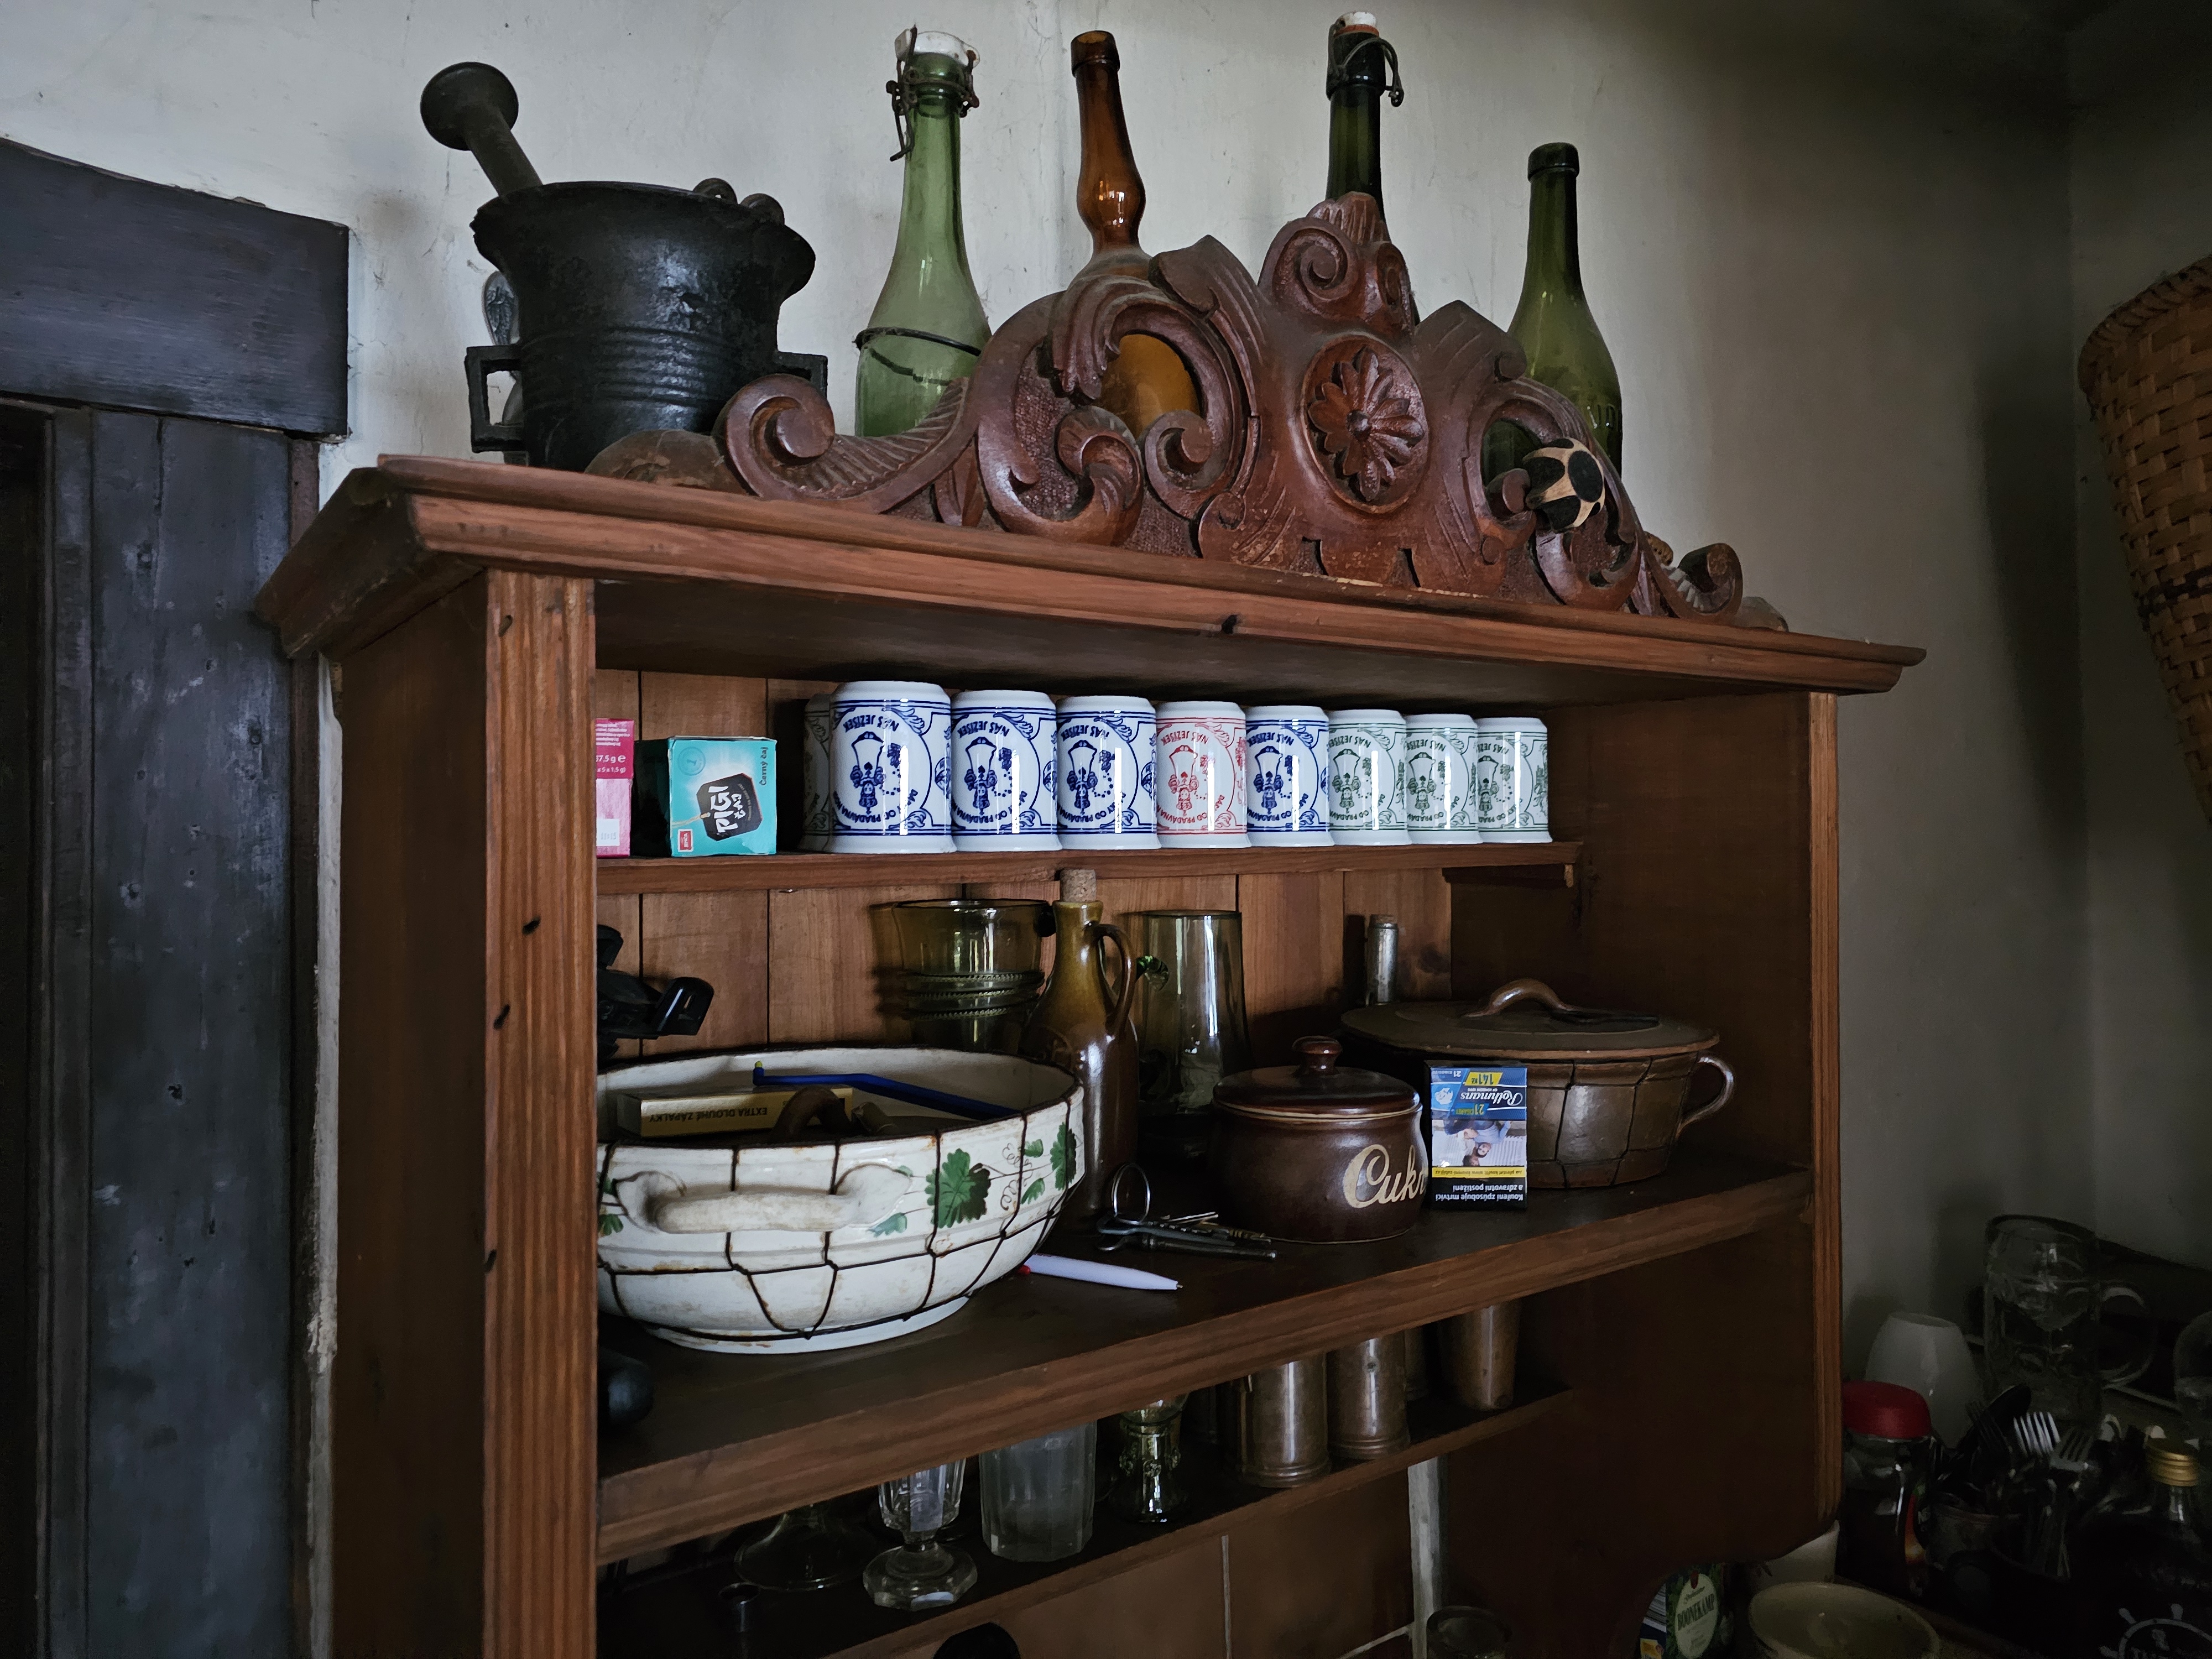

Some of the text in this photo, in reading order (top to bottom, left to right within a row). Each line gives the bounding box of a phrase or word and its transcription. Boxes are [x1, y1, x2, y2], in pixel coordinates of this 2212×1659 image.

[759, 761, 768, 785] Černý
[708, 786, 738, 833] PIGI
[1095, 811, 1107, 820] OD
[1197, 812, 1207, 821] OD
[1478, 1073, 1494, 1085] 141
[1460, 1091, 1523, 1106] Rothmans
[738, 1107, 768, 1118] EXTRA
[1474, 1104, 1484, 1115] 21
[649, 1112, 693, 1123] ZÁPALKY
